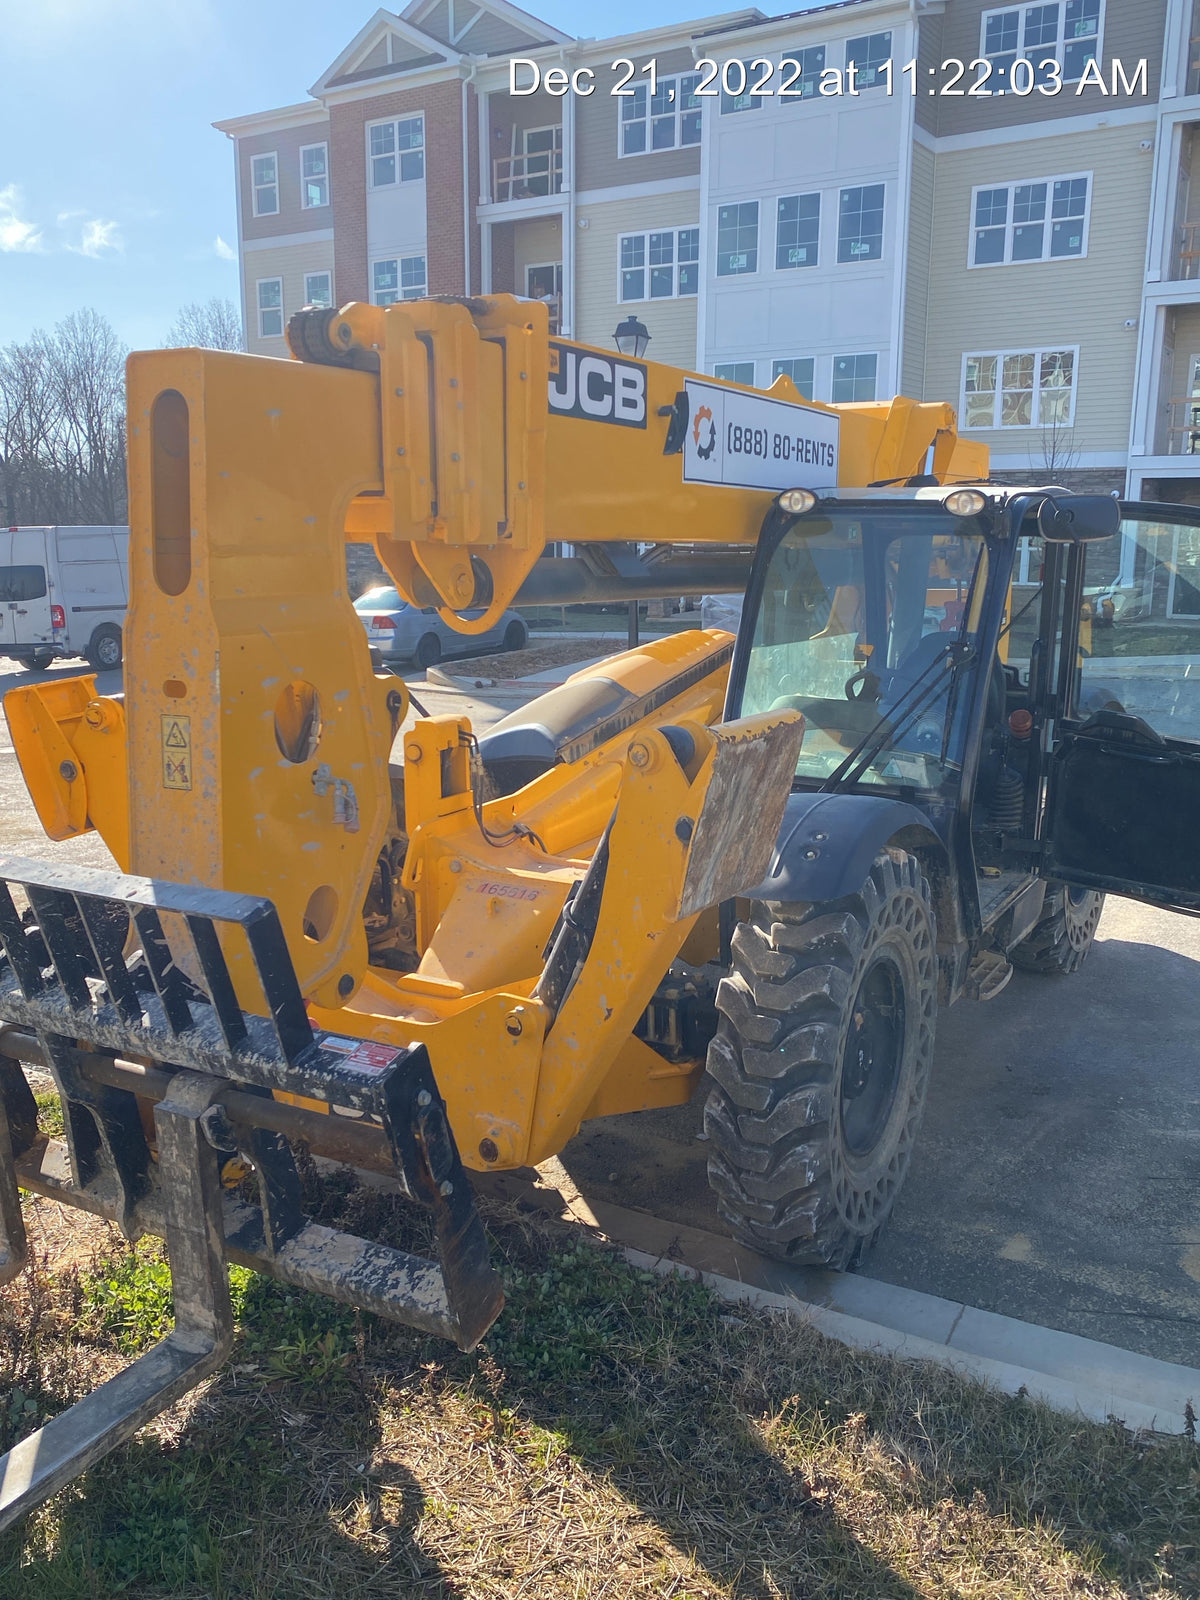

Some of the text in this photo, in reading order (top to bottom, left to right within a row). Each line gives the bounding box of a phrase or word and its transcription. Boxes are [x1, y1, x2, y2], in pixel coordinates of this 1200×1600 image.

[548, 352, 645, 422] JCB
[728, 422, 834, 467] (888) 80-RENTS
